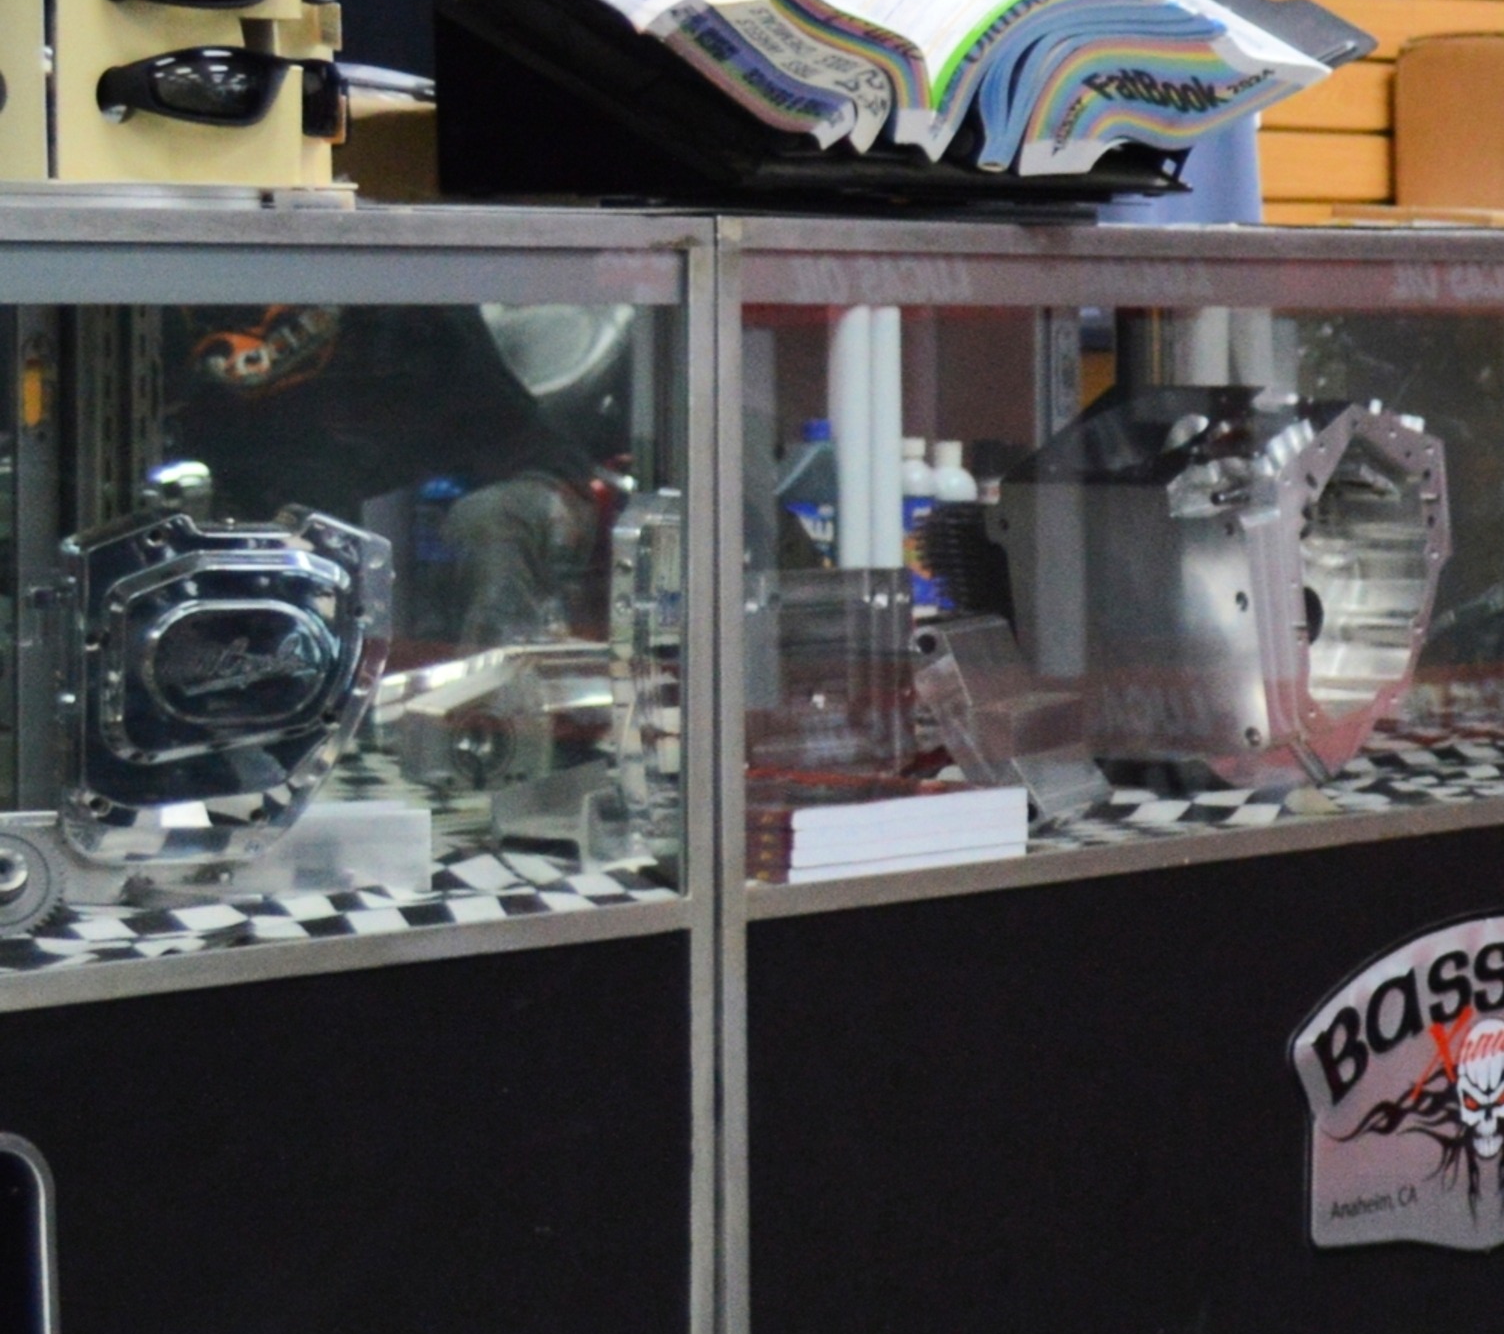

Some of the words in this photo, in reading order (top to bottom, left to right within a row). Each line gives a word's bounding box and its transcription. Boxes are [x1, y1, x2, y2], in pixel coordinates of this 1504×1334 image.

[1082, 68, 1231, 113] FatBook
[1329, 1186, 1395, 1221] Anaheim,
[1396, 1183, 1421, 1207] CA
